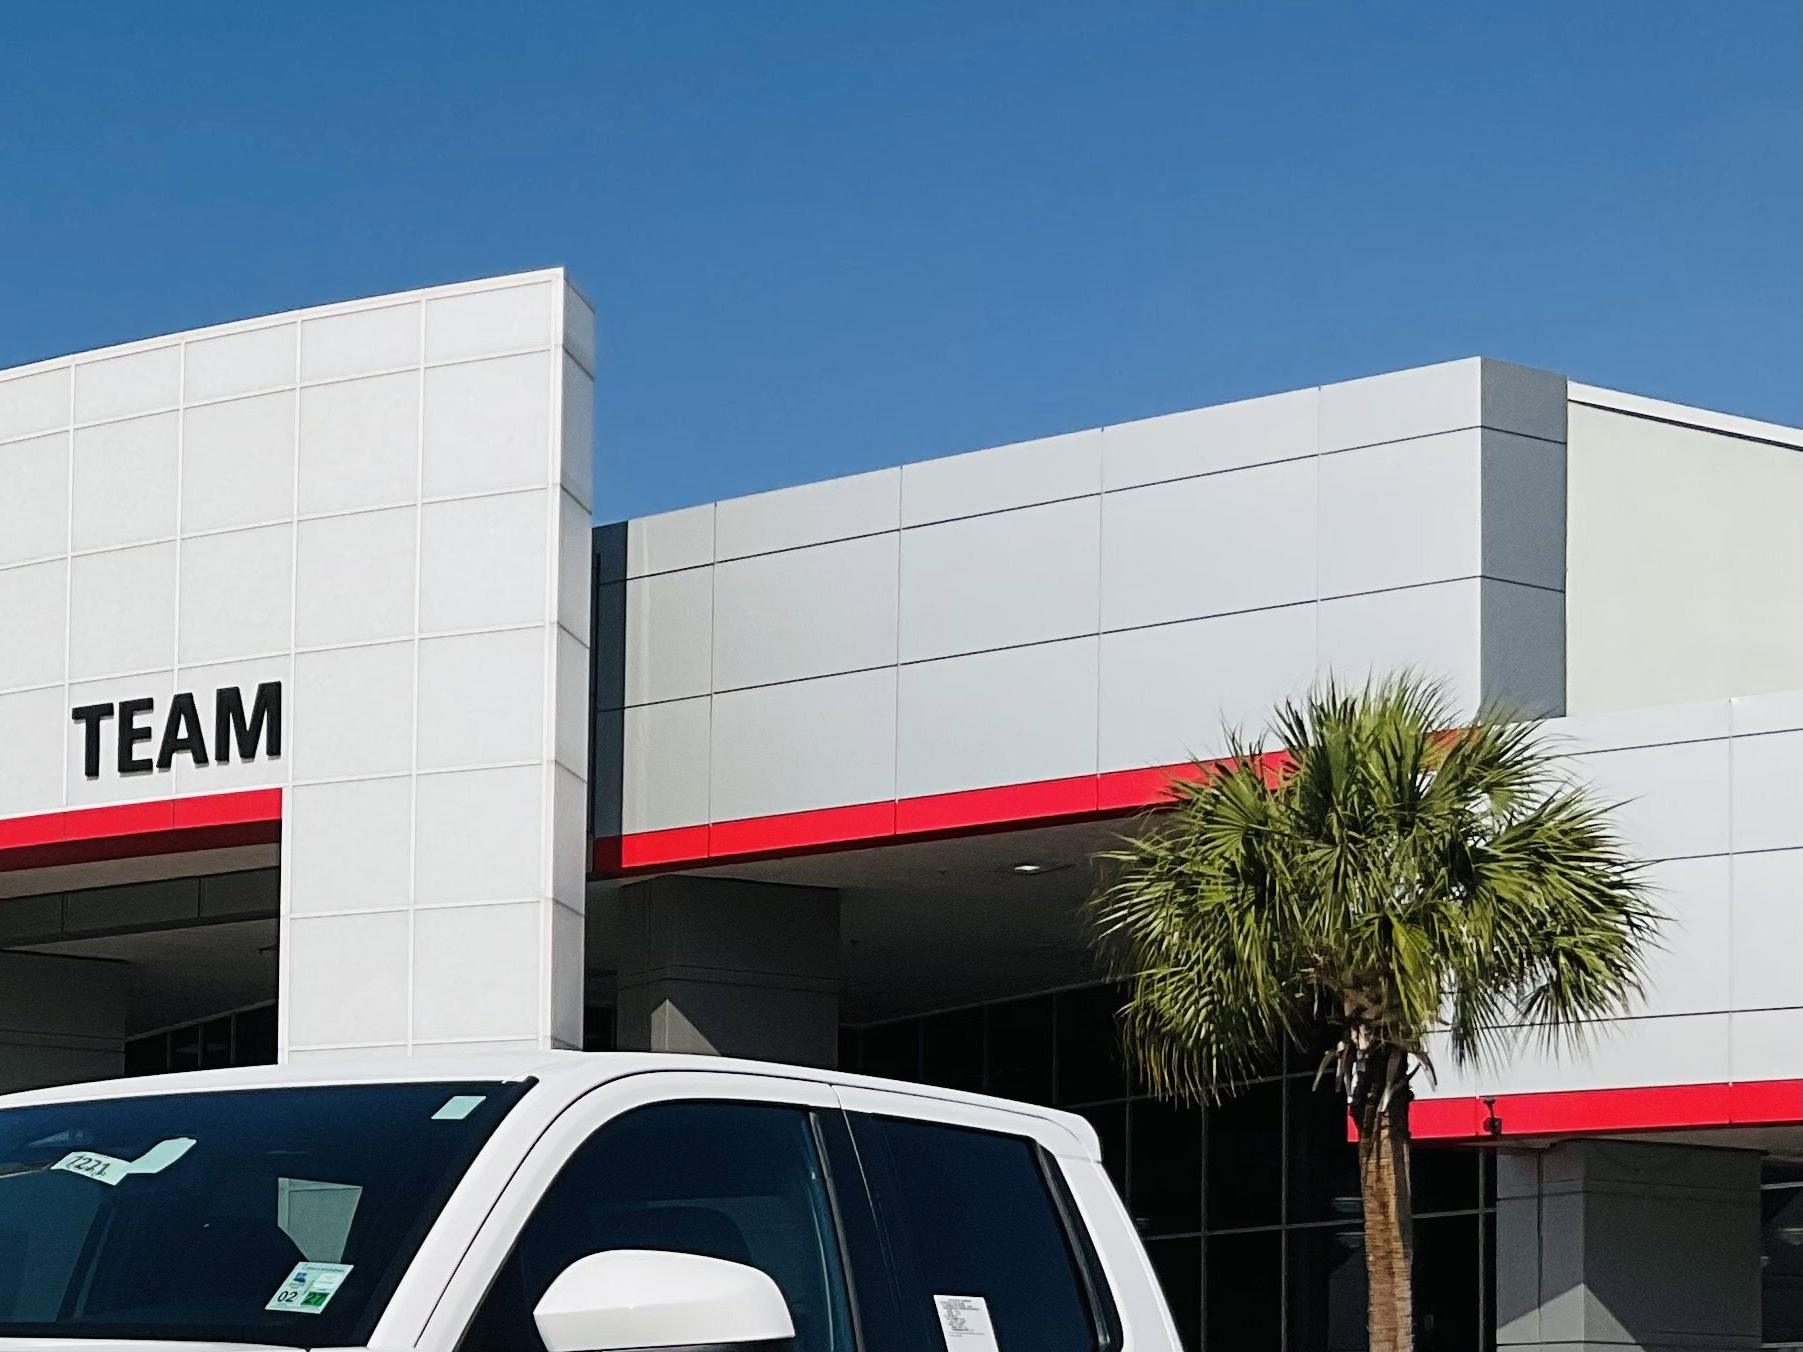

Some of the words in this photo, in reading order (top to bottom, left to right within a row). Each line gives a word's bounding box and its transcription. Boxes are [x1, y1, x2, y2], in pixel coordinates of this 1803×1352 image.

[71, 681, 283, 778] TEAM
[277, 1291, 298, 1303] 02
[303, 1292, 327, 1305] 27
